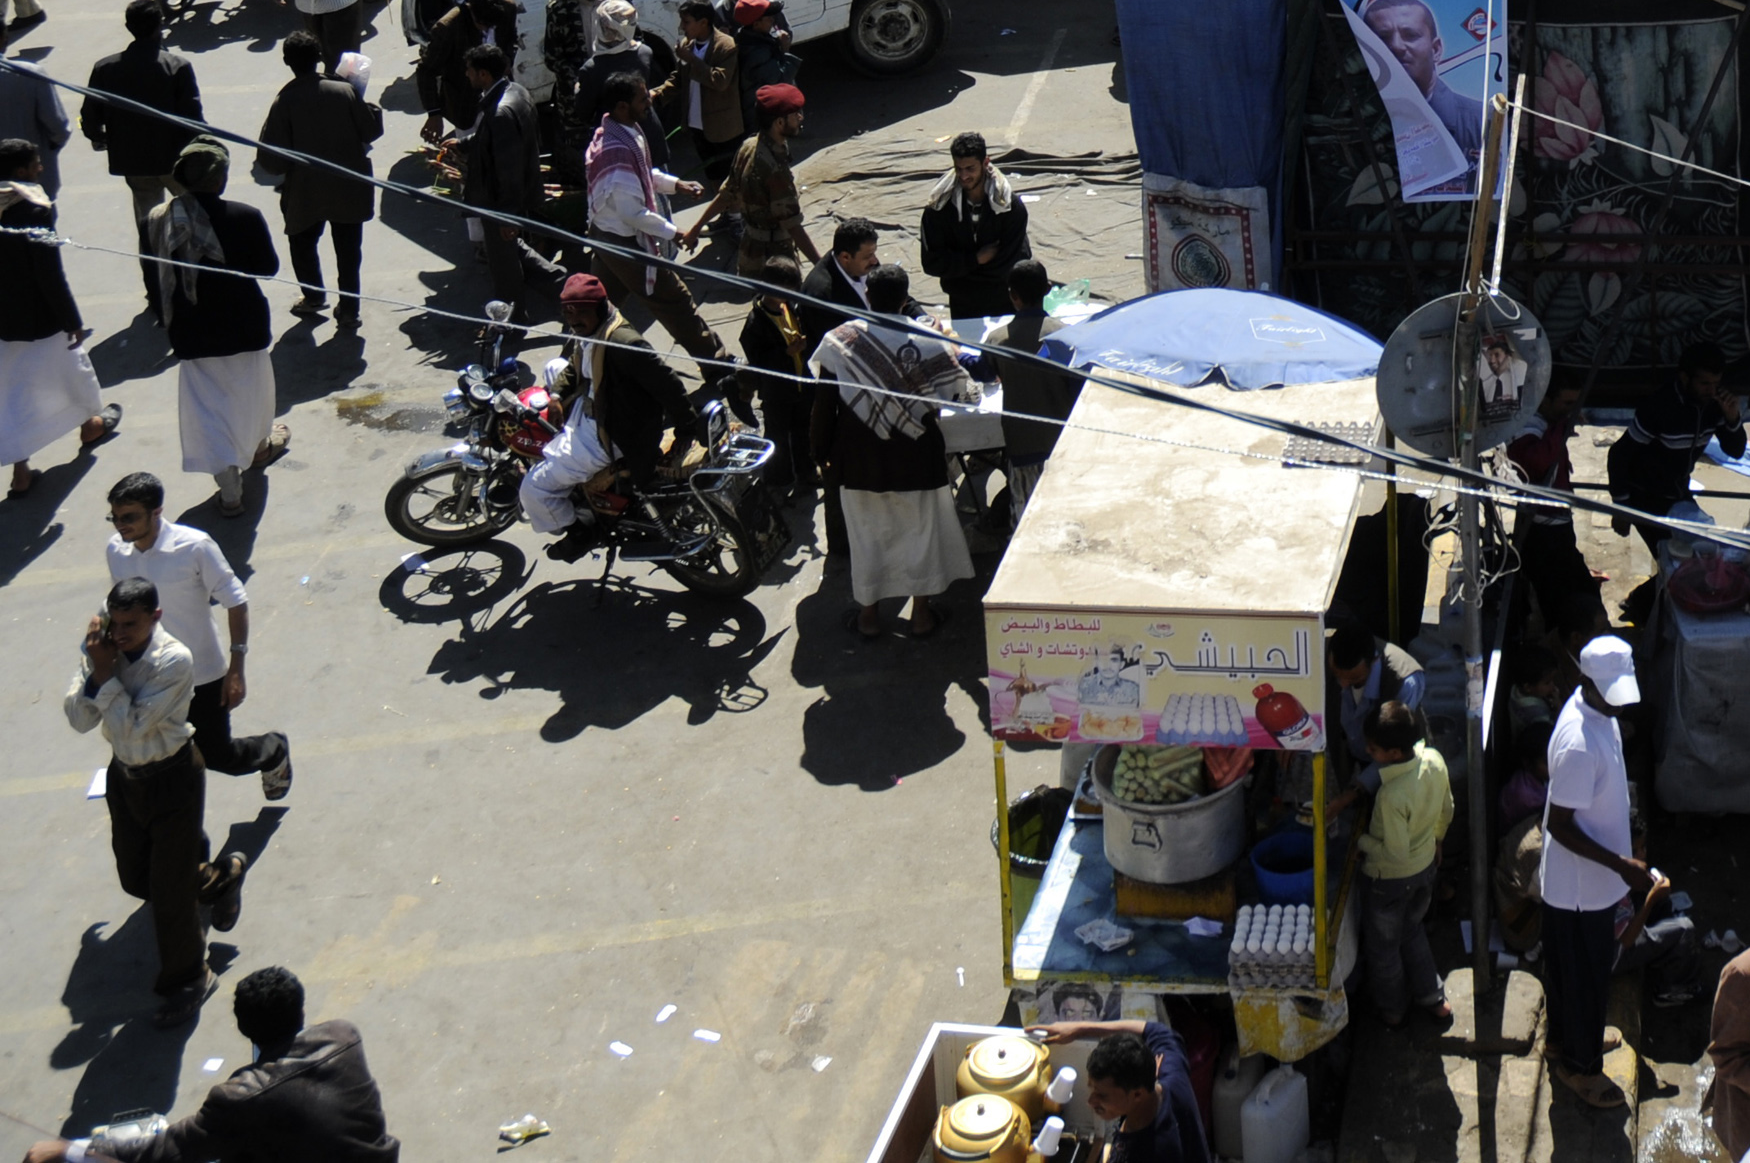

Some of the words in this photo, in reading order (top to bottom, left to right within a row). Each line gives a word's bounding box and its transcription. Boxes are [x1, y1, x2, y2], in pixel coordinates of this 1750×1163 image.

[1001, 616, 1051, 634] والبيض
[1053, 617, 1101, 635] للبطاط
[1000, 642, 1034, 658] الشاي
[1144, 630, 1309, 680] الحبيشي
